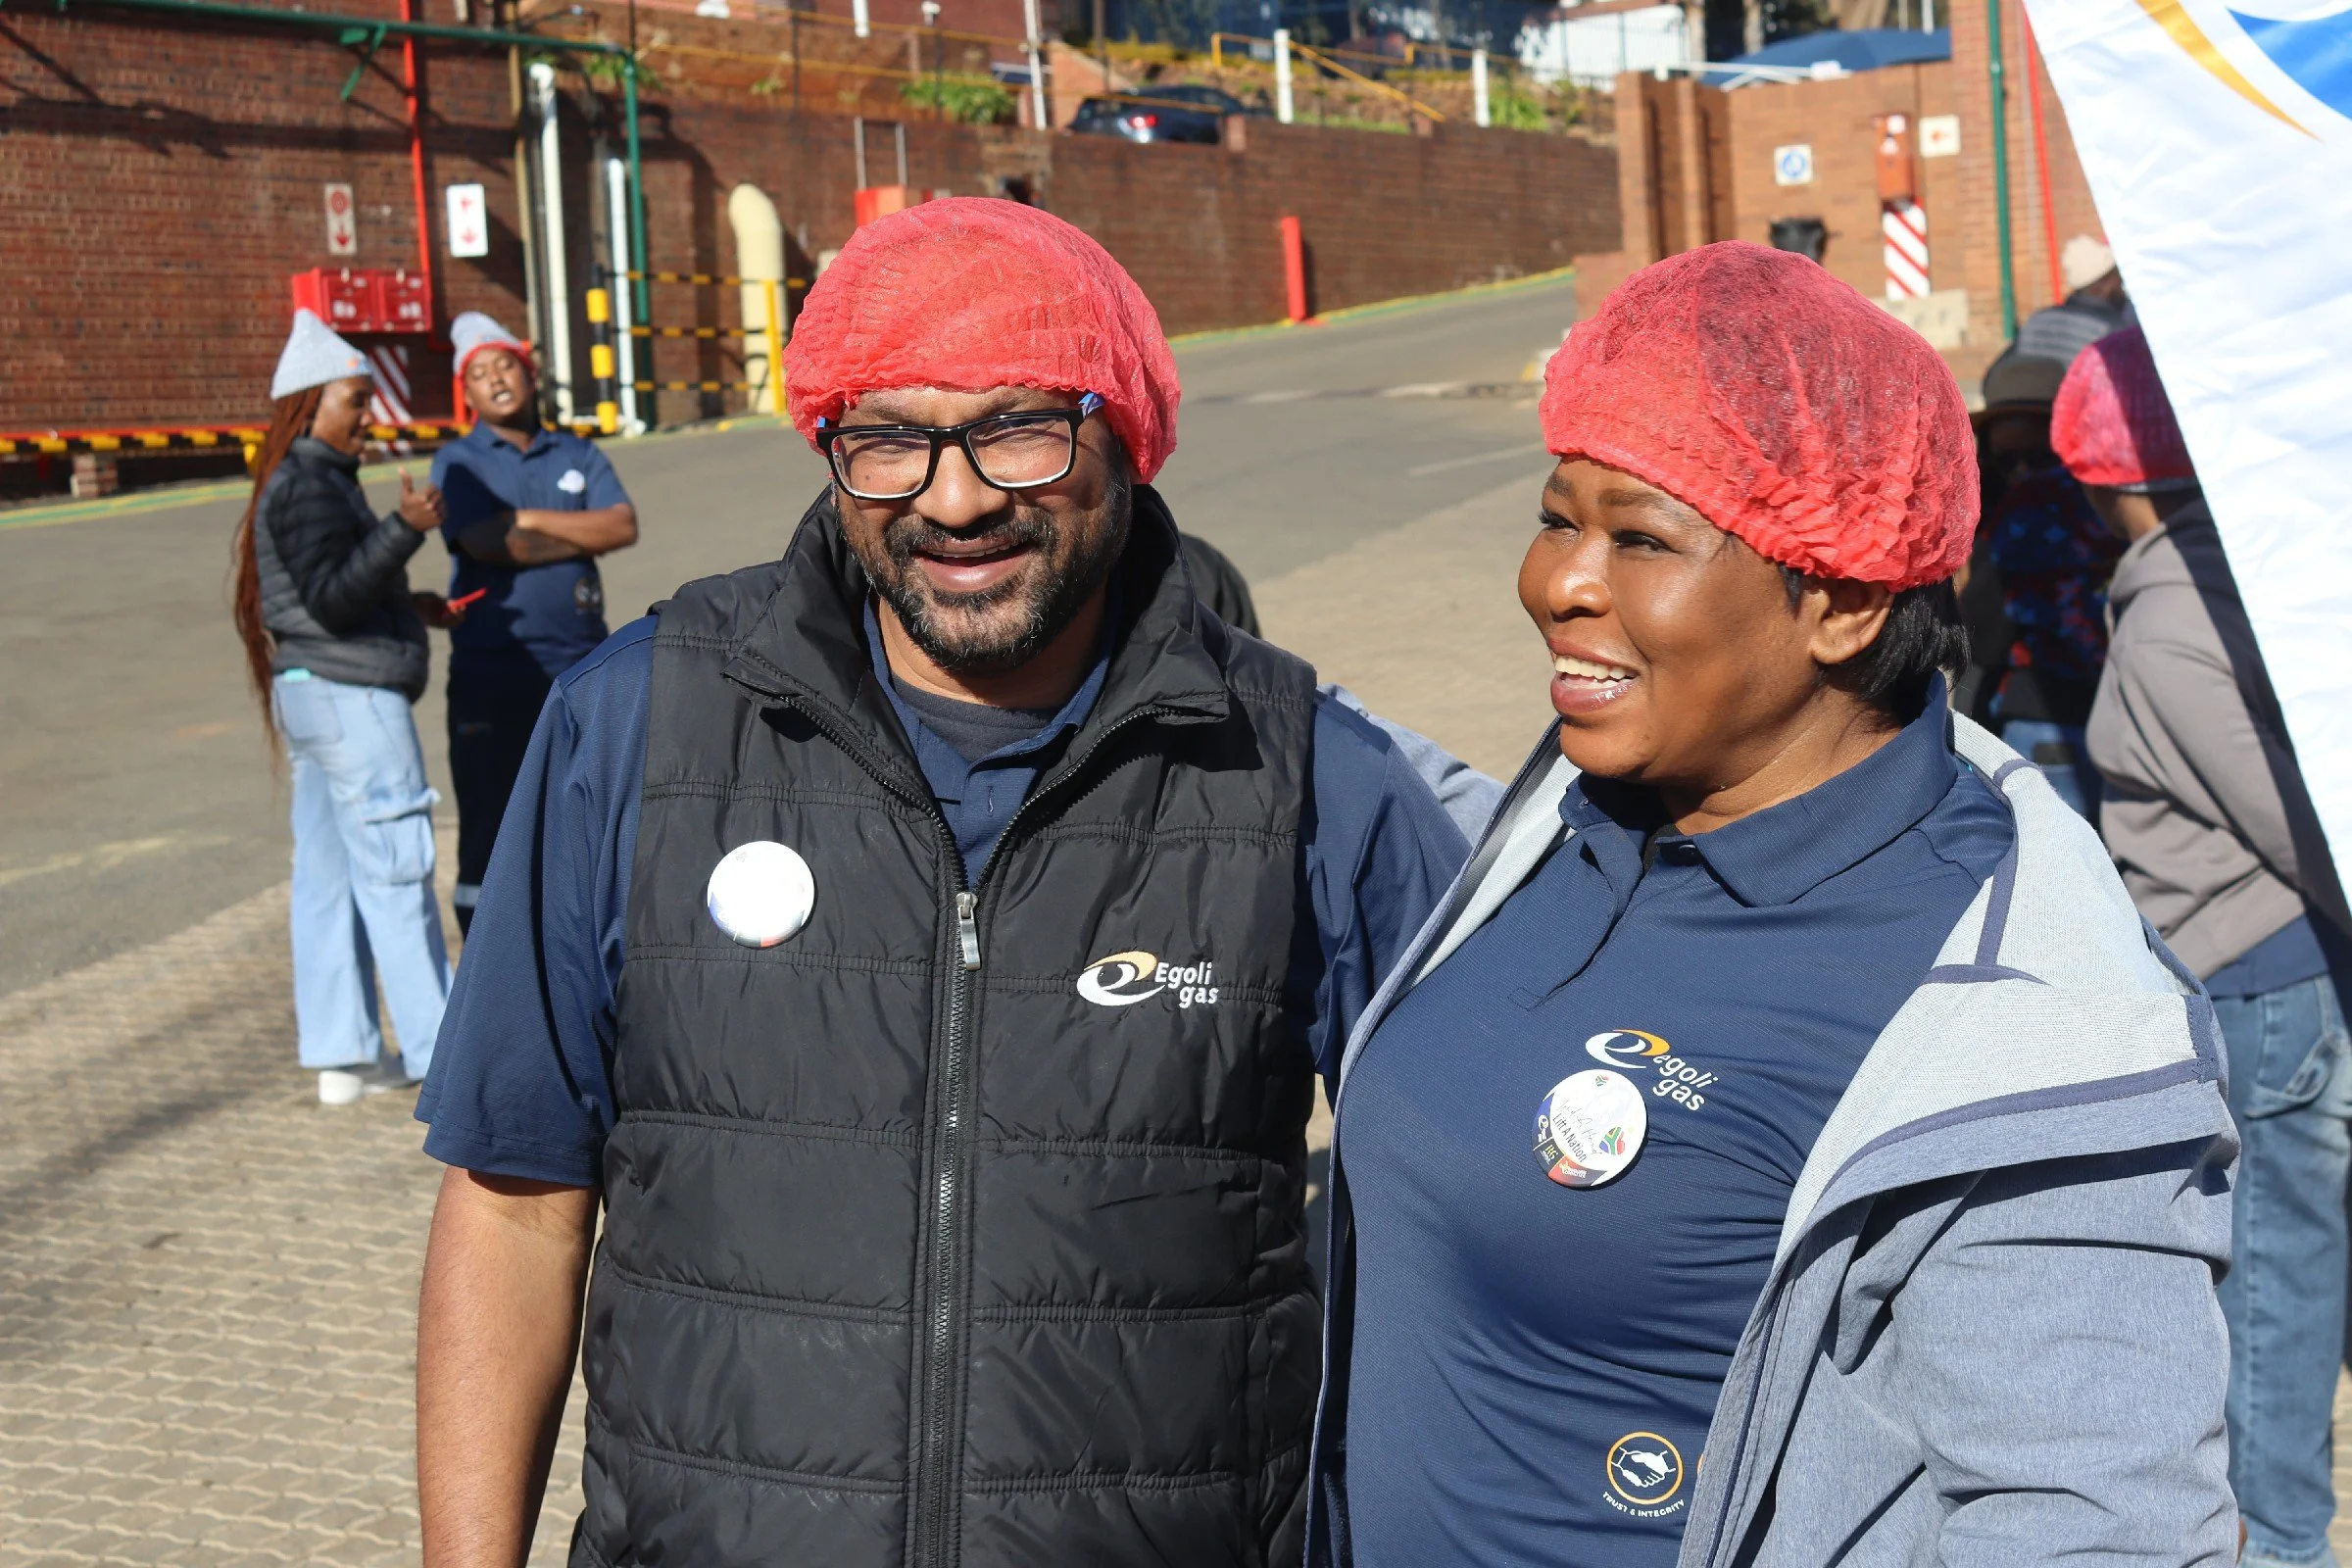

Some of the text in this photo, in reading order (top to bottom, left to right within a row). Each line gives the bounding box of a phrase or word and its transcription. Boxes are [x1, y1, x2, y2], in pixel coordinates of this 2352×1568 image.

[1154, 961, 1212, 990] Egoli
[1179, 986, 1219, 1009] gas
[1652, 1079, 1705, 1111] gas
[1552, 1112, 1567, 1131] Lift
[1560, 1126, 1572, 1138] A
[1564, 1130, 1588, 1163] Nation
[1602, 1491, 1628, 1513] TRUST
[1638, 1498, 1686, 1518] INTEGRITY
